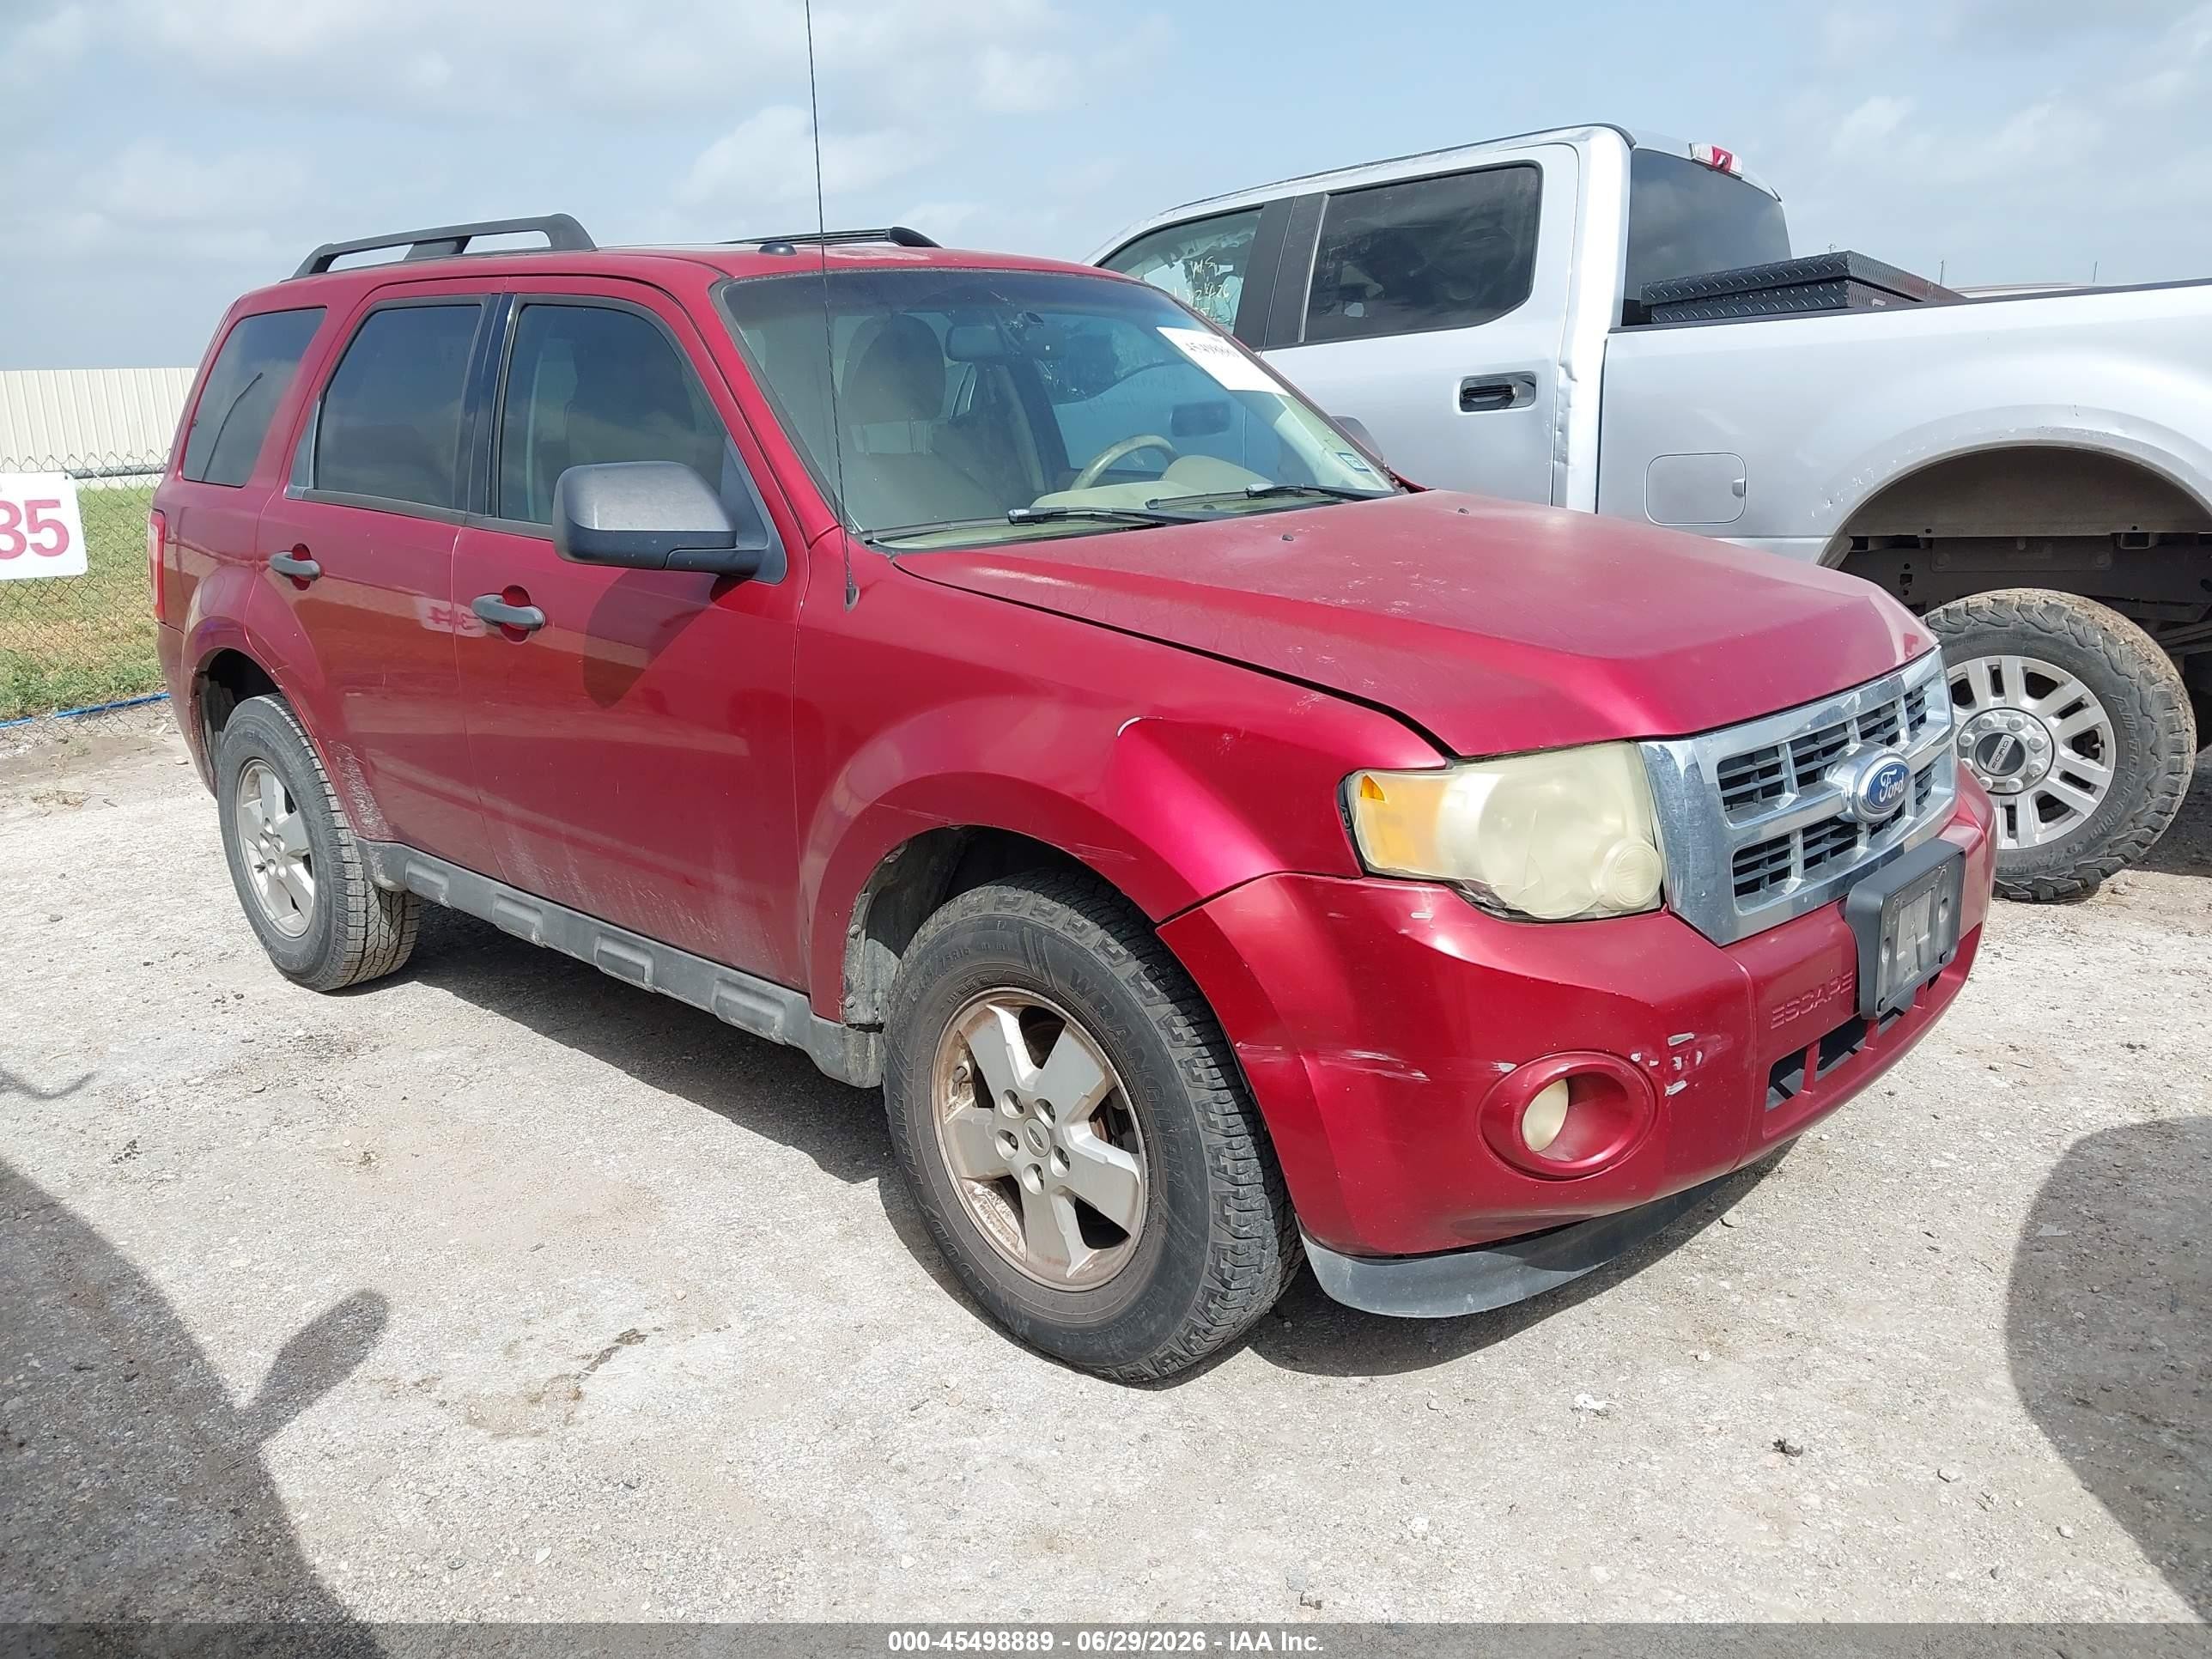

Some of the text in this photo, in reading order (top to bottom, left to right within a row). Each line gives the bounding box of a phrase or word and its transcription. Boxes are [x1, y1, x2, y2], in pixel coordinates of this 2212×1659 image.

[1991, 740, 2009, 769] FORD
[1879, 769, 1905, 802] Ford
[1770, 970, 1854, 1030] ESCAPE
